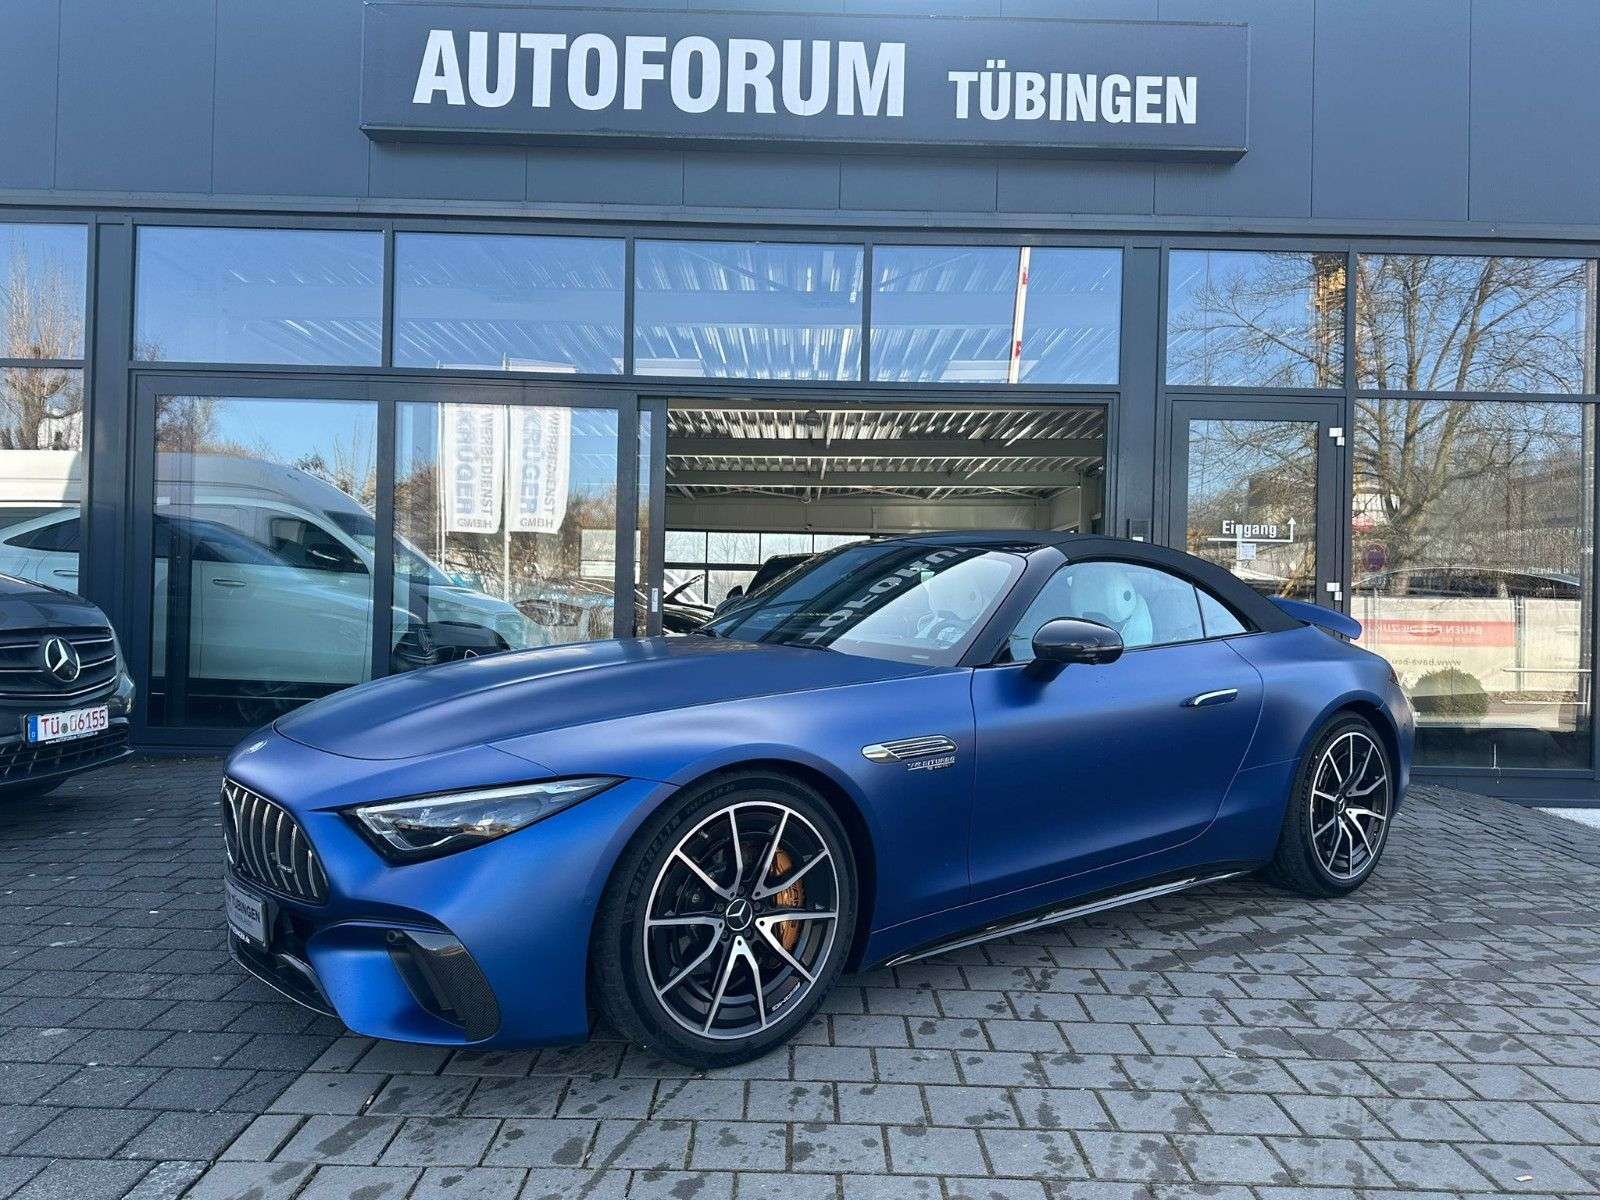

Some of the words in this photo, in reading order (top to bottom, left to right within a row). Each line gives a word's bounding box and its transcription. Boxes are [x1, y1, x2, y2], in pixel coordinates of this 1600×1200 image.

[413, 30, 905, 116] AUTOFORUM
[949, 60, 1196, 123] TÜBINGEN
[1222, 519, 1277, 538] Eingang
[41, 715, 60, 736] TÜ
